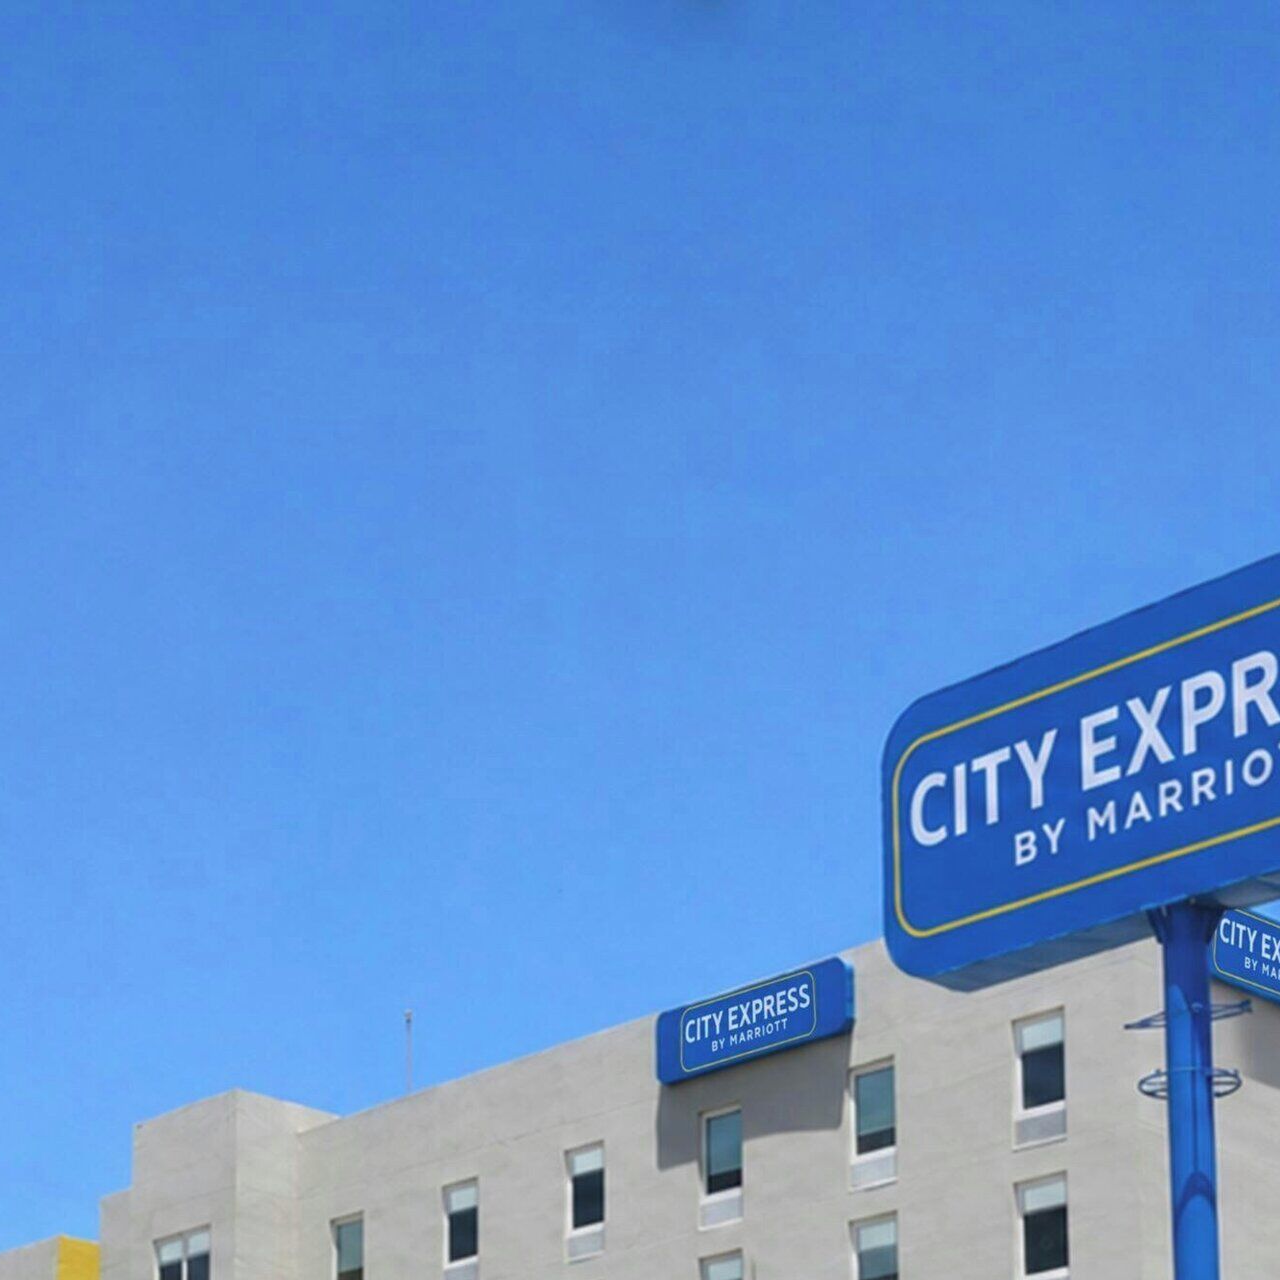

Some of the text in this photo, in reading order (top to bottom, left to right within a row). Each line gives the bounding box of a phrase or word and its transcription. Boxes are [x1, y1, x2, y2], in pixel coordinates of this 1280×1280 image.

[909, 730, 1057, 847] CITY
[1014, 819, 1066, 866] BY
[1220, 917, 1258, 953] CITY
[1244, 957, 1258, 971] BY
[685, 983, 811, 1044] CITY EXPRESS
[711, 1018, 789, 1052] BY MARRIOTT
